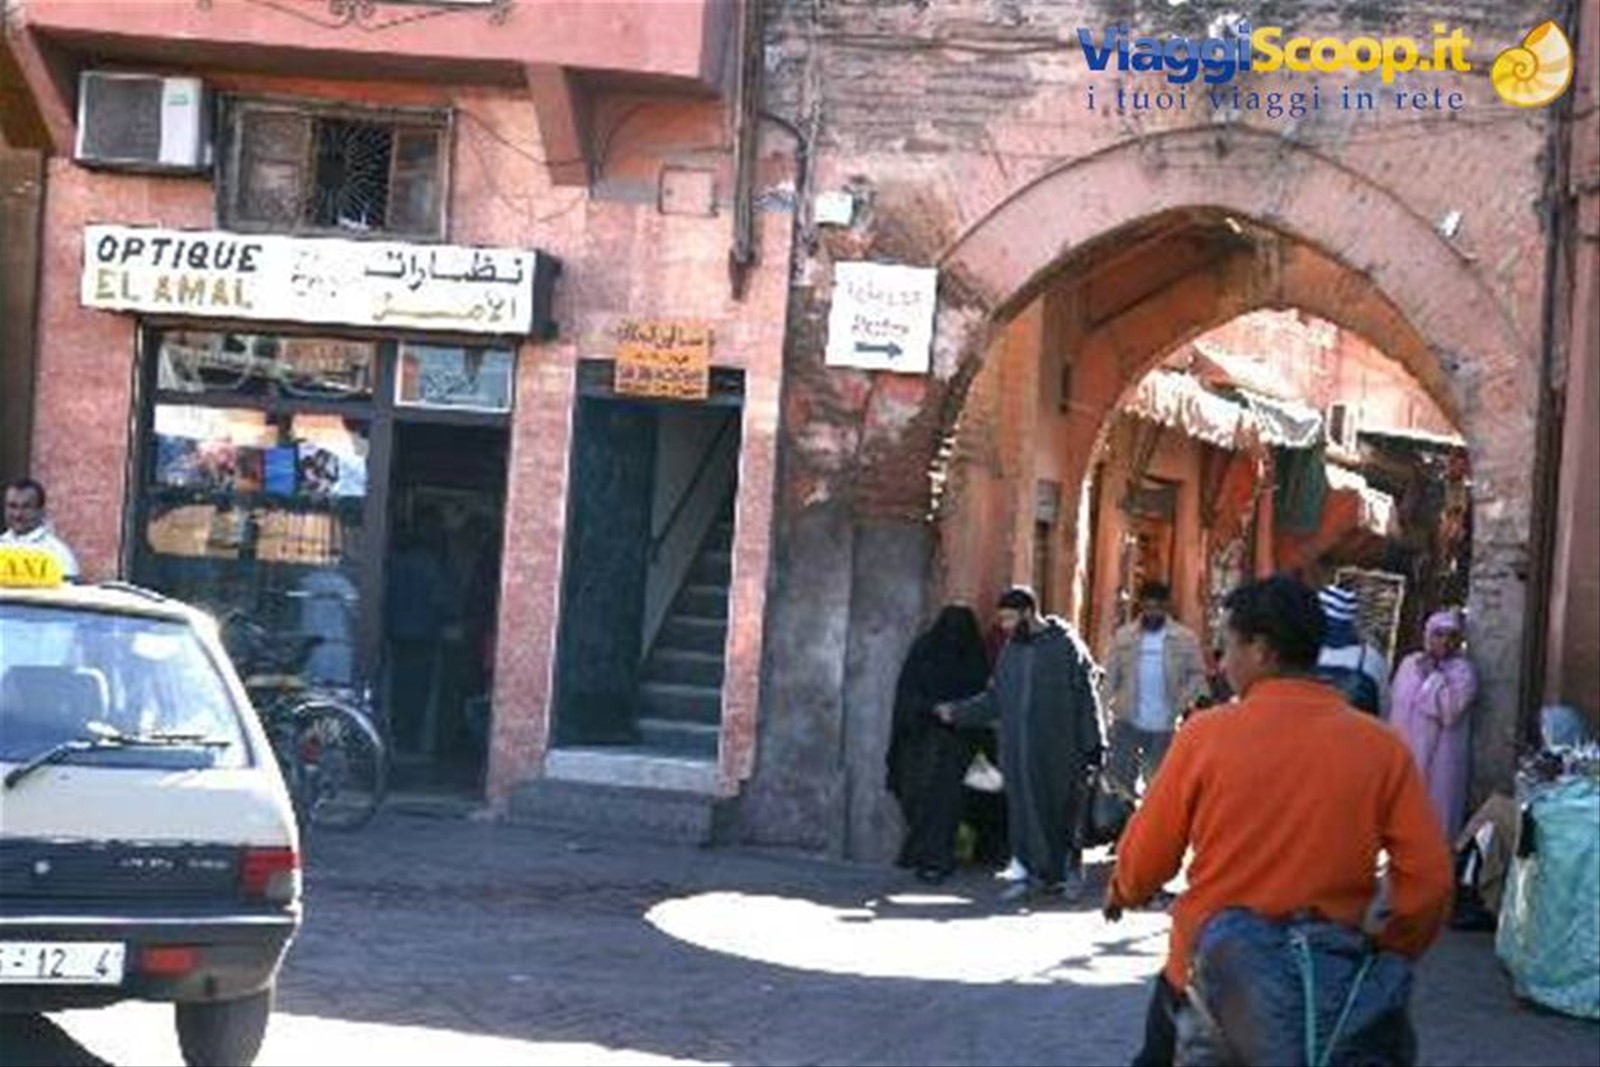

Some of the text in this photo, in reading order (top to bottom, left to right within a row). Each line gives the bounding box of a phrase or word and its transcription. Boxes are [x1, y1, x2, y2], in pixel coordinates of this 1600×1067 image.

[96, 234, 263, 272] OPTIQUE
[95, 268, 254, 310] EL AMAL
